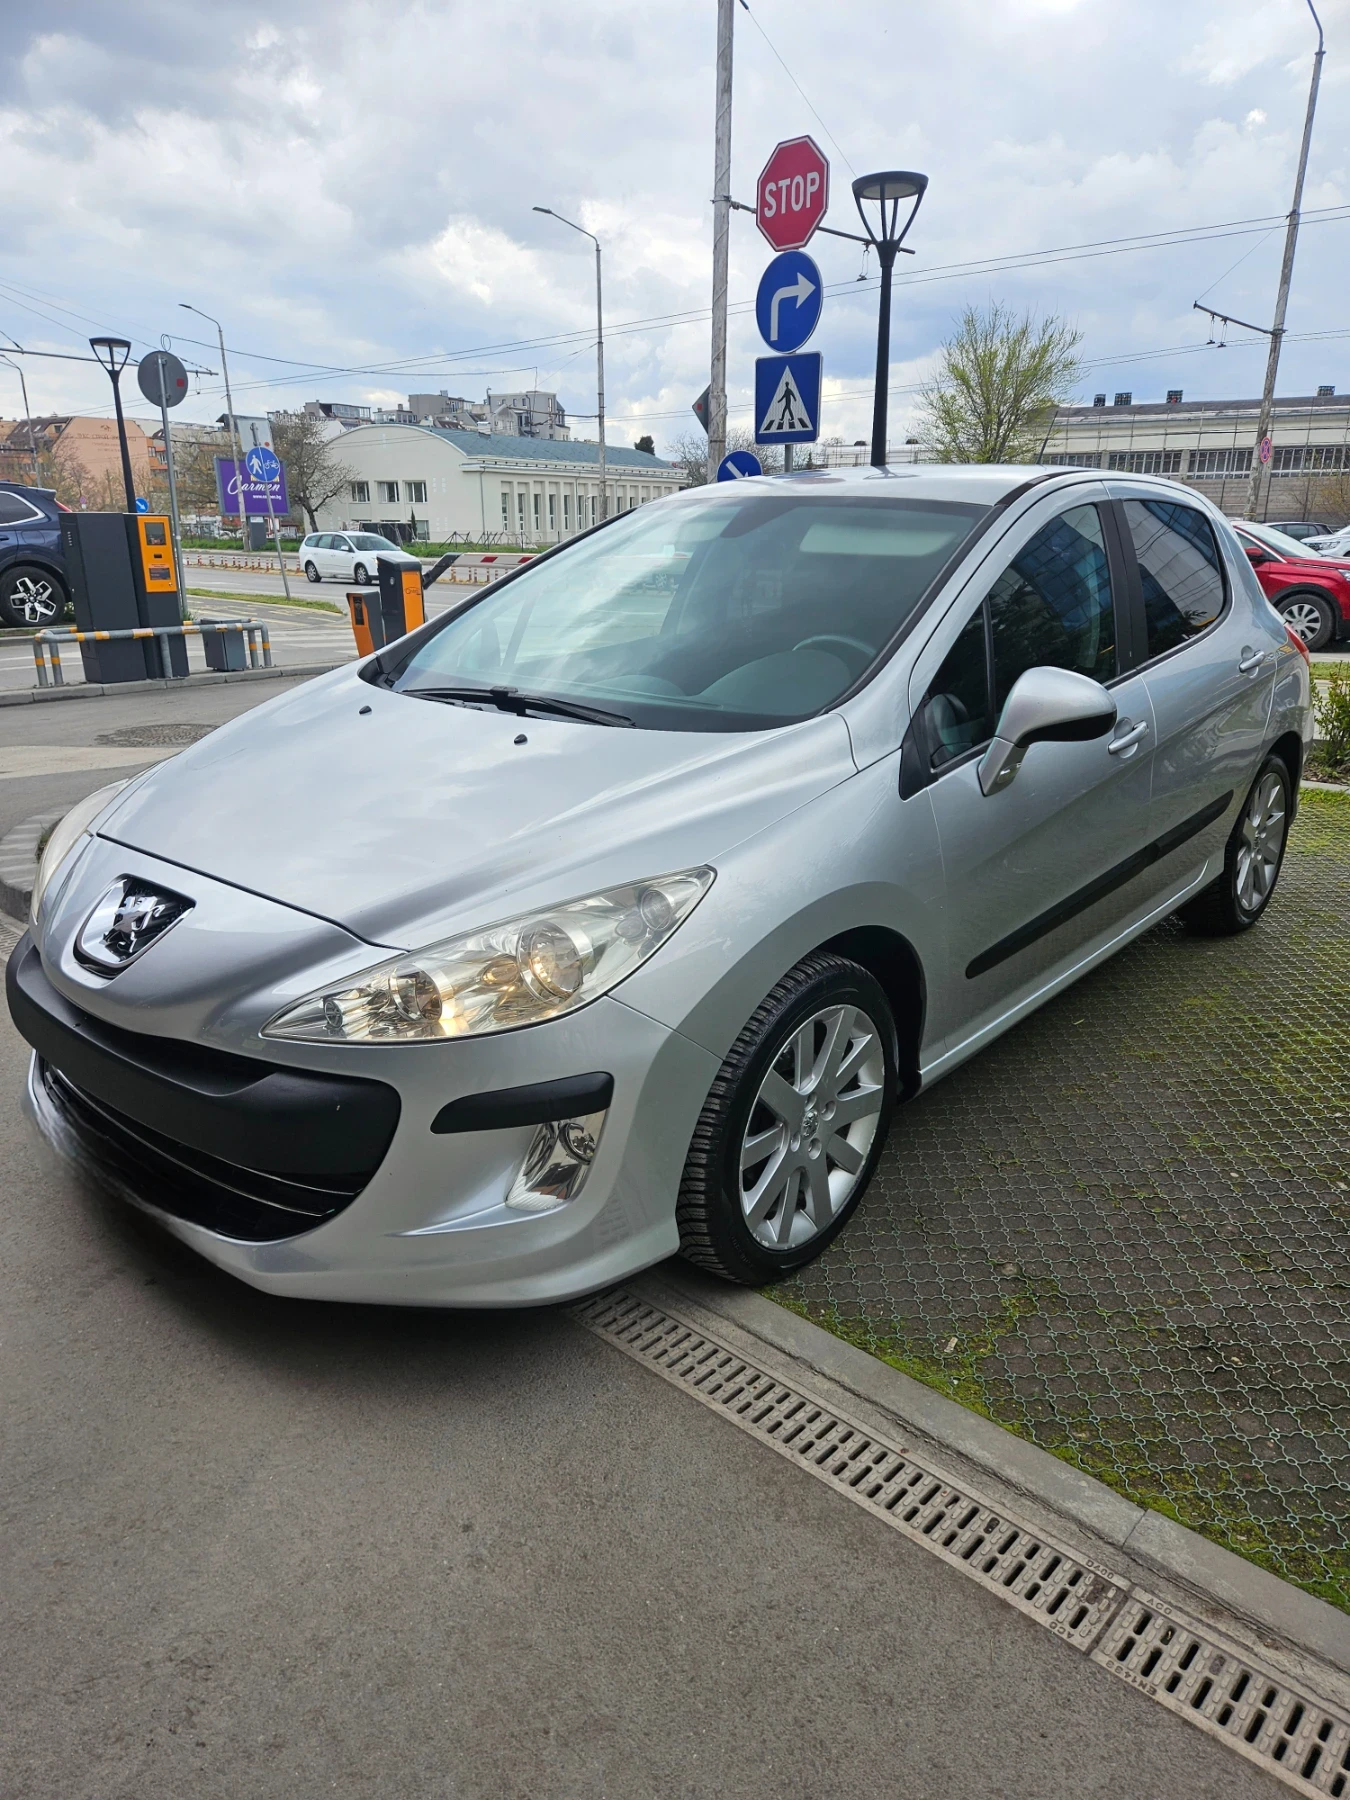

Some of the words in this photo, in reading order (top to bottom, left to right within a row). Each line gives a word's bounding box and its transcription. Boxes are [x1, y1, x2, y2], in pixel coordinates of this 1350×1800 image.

[763, 171, 820, 218] STOP
[227, 474, 281, 495] Carmen
[1085, 1559, 1115, 1580] D400
[1146, 1598, 1173, 1616] ACO
[1049, 1621, 1075, 1639] ACO
[1106, 1660, 1157, 1696] EN1433
